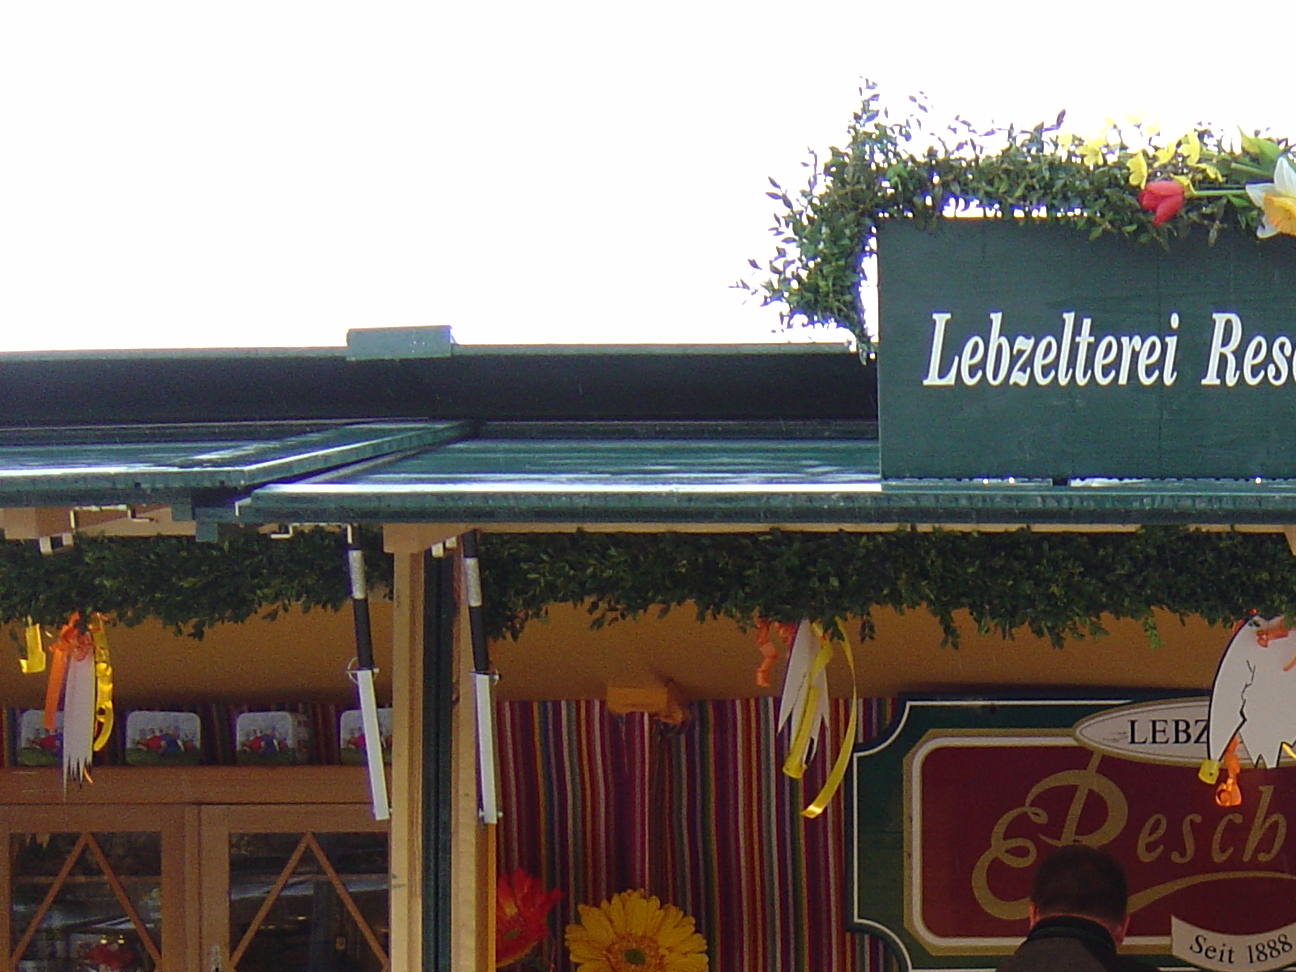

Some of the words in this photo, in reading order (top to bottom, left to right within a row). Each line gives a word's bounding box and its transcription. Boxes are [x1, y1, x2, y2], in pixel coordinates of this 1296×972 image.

[922, 311, 1179, 388] Lebzelterei
[1189, 934, 1235, 964] Seit
[1248, 933, 1293, 964] 1888
